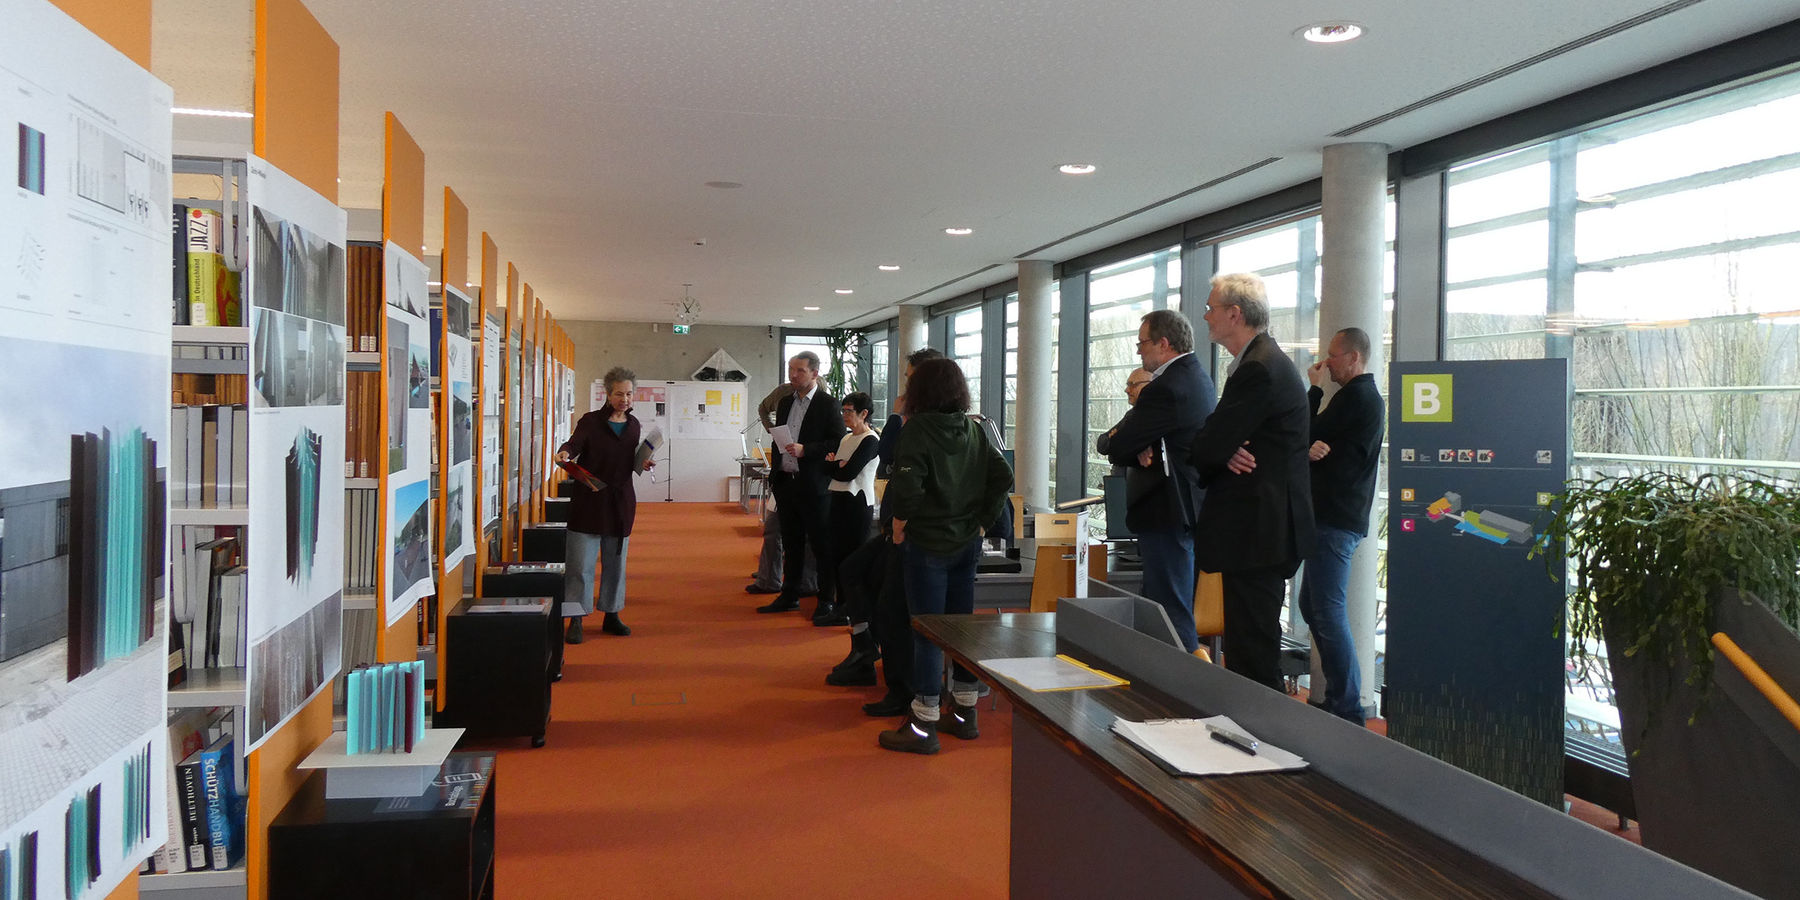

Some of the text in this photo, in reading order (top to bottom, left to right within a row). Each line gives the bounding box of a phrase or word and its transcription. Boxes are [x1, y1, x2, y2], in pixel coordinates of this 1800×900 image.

[190, 219, 209, 251] JAZZ
[193, 258, 201, 293] Deutschland
[1413, 382, 1441, 415] B
[1404, 490, 1412, 499] D
[1540, 494, 1548, 504] B
[1403, 520, 1411, 530] C
[185, 767, 197, 822] BEETHOVEN
[204, 758, 225, 847] SCHÜTZHANDBU
